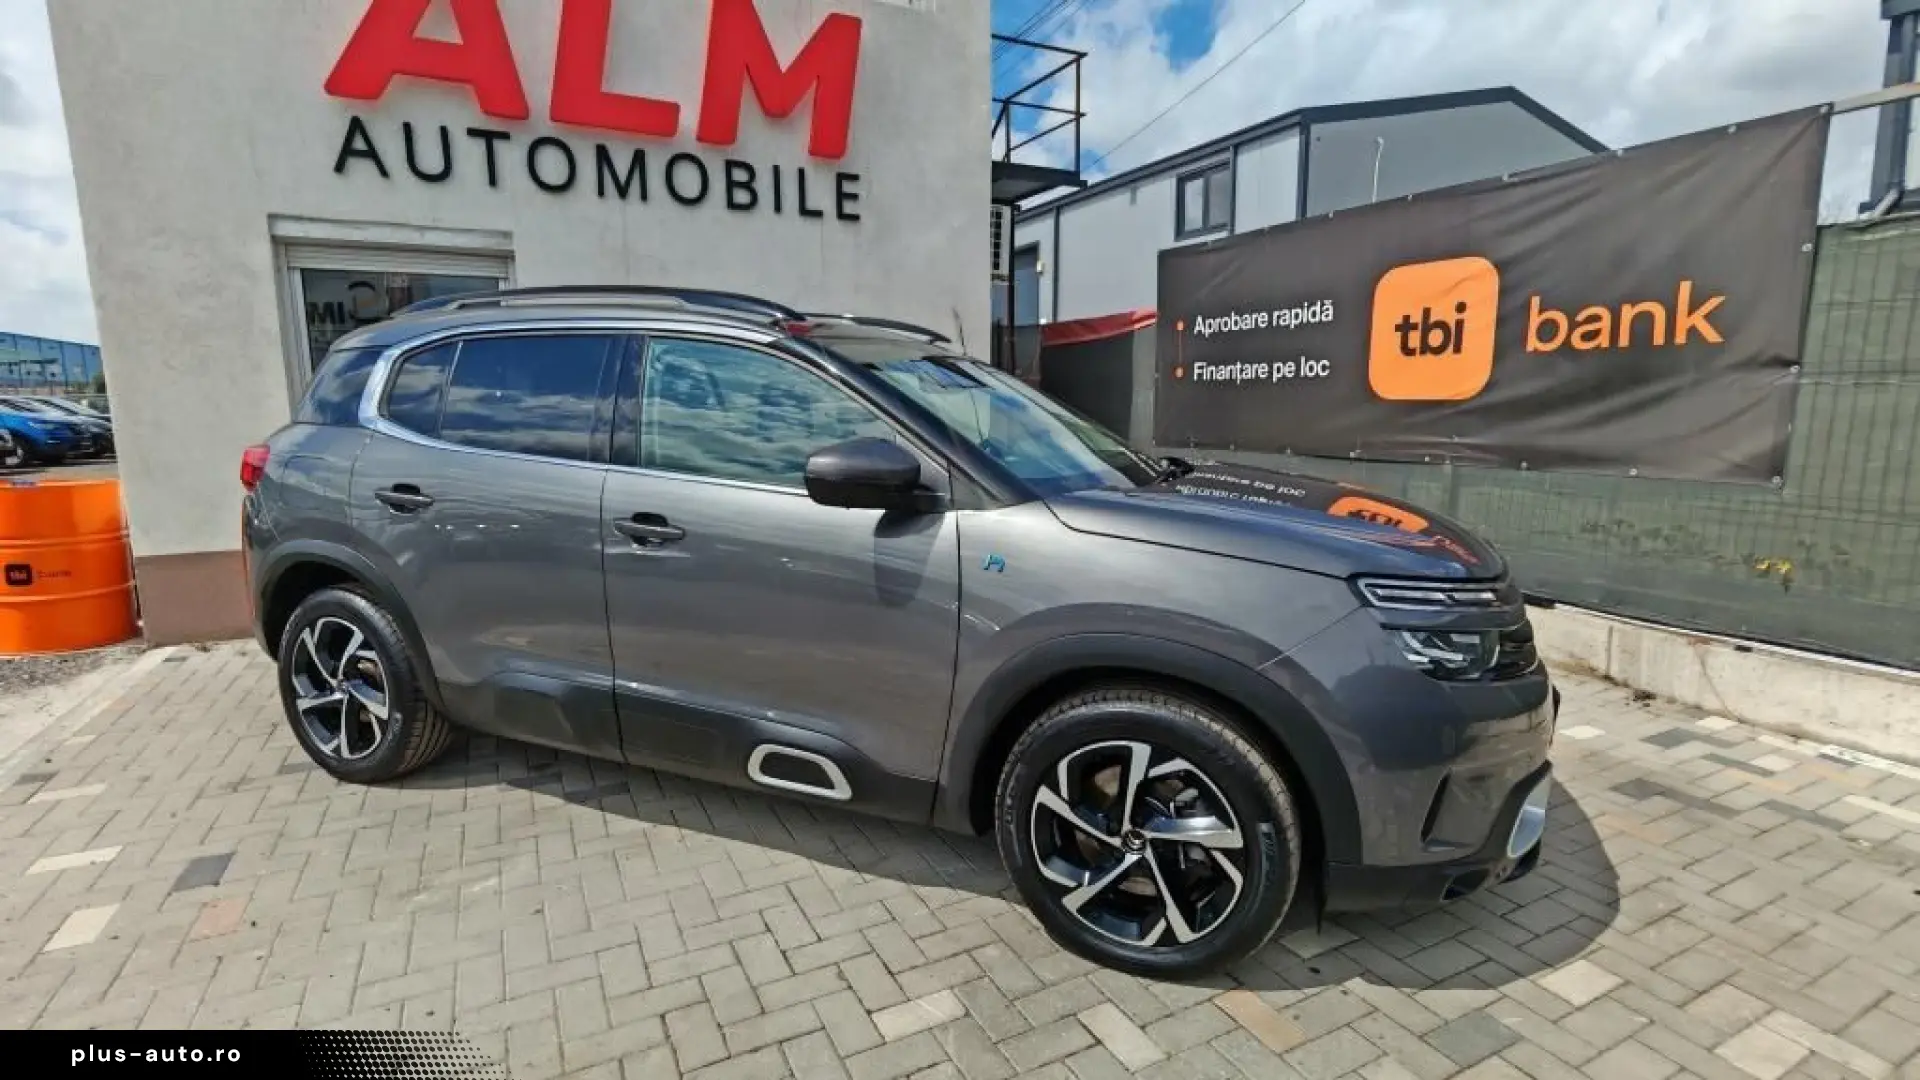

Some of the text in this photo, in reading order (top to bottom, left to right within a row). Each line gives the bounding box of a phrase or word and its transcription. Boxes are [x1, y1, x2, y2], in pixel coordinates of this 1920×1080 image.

[324, 0, 862, 159] ALM
[334, 116, 861, 221] AUTOMOBILE
[1193, 299, 1334, 338] Aprobare rapidă
[1394, 280, 1726, 356] tbi bank
[1193, 356, 1331, 384] Finanțare pe loc
